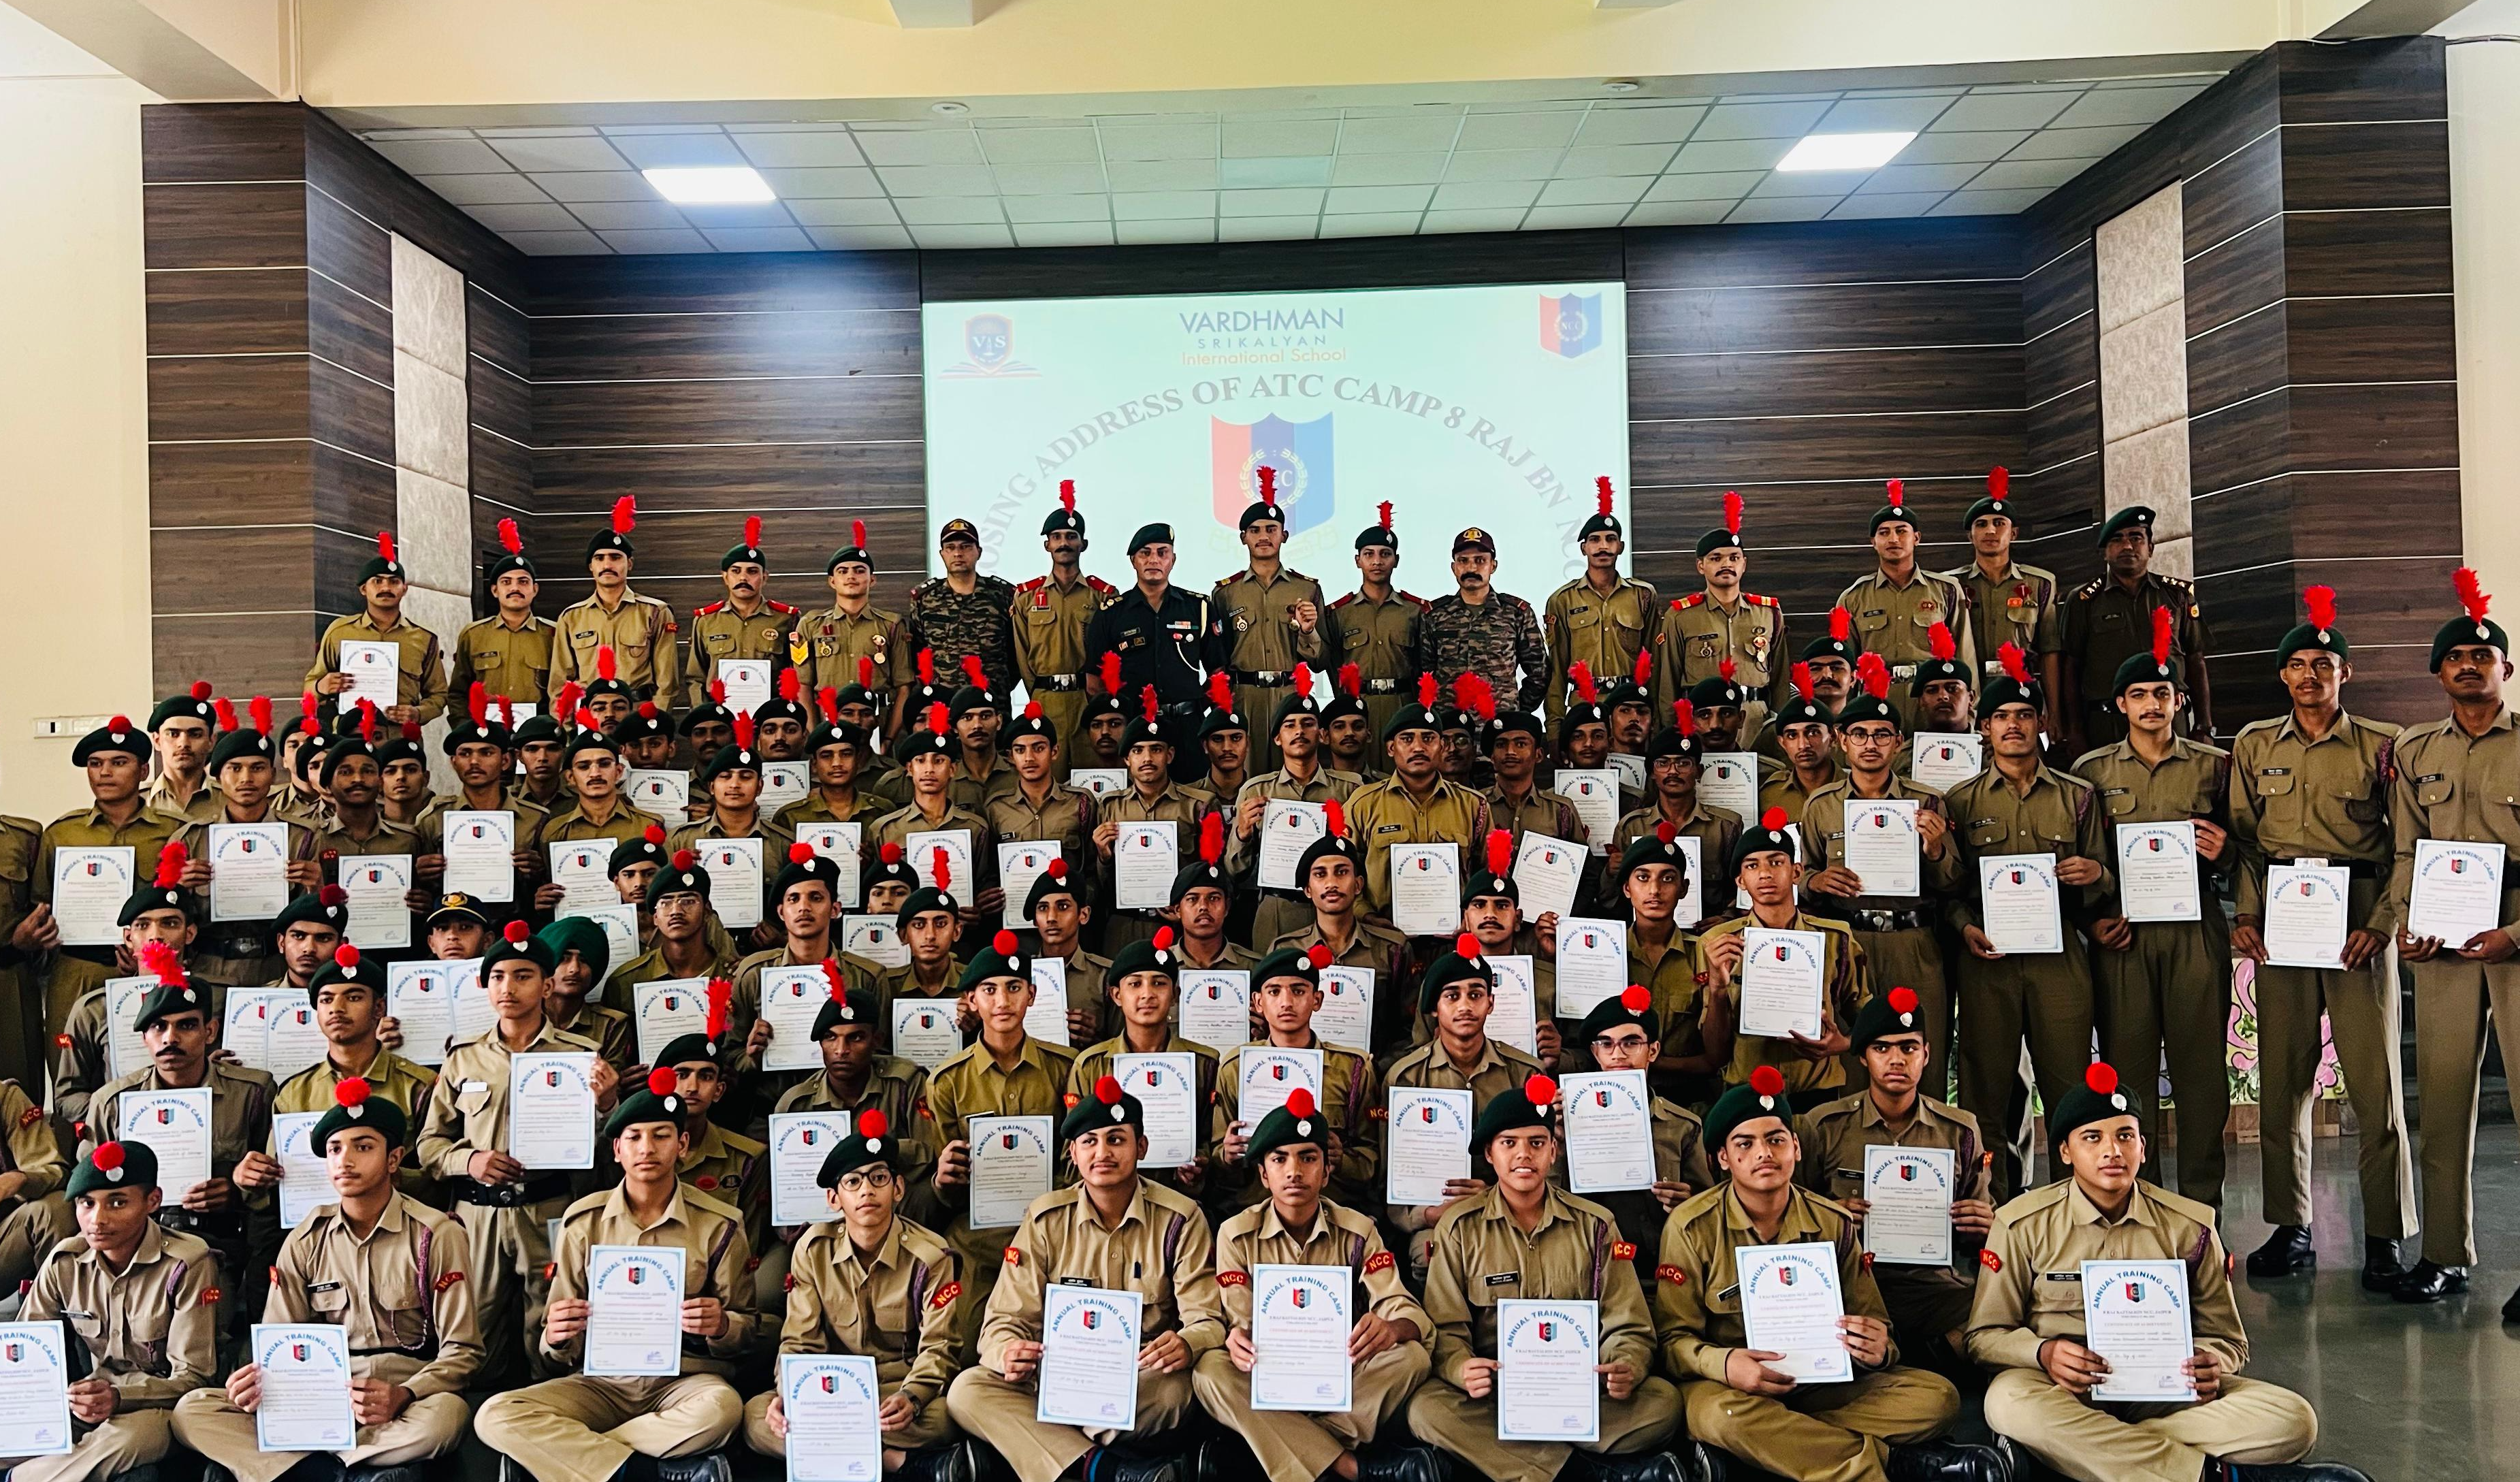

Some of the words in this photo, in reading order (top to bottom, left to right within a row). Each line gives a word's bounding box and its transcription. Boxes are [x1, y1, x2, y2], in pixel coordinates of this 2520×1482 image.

[1179, 308, 1344, 334] VARDHMAN
[1182, 349, 1285, 366] International
[1291, 347, 1346, 362] School
[1198, 335, 1326, 349] SRIKALYAN
[978, 472, 1037, 570] OSING
[1035, 388, 1184, 479] ADDRESS
[1192, 377, 1242, 405] OF
[1250, 374, 1324, 398] ATC
[1334, 377, 1444, 419] CAMP
[1444, 406, 1467, 429] 8
[1465, 415, 1537, 468] RAJ
[1524, 463, 1572, 509] BN
[1492, 964, 1515, 974] AINING
[1770, 937, 1805, 950] TRAINING
[1805, 950, 1816, 969] CAMP
[519, 1067, 539, 1093] ANNUAL
[540, 1061, 577, 1072] TRAINING
[577, 1072, 589, 1092] CAMP
[1141, 1061, 1176, 1072] TRAINING
[1176, 1072, 1189, 1092] CAMP
[1246, 1060, 1265, 1084] ANNUAL
[1267, 1055, 1303, 1068] TRAINING
[1303, 1068, 1315, 1089] CAMP
[1570, 1088, 1588, 1114] ANNUAL
[1589, 1080, 1626, 1092] TRAINING
[1627, 1091, 1641, 1111] CAMP
[22, 1108, 40, 1125] NCC
[128, 1106, 150, 1132] ANNUAL
[151, 1099, 190, 1109] TRAINING
[191, 1109, 204, 1128] CAMP
[1395, 1101, 1415, 1127] ANNUAL
[1417, 1097, 1453, 1110] TRAINING
[1453, 1110, 1465, 1131] CAMP
[283, 1127, 302, 1153] ANNUAL
[777, 1126, 796, 1152] ANNUAL
[796, 1121, 831, 1130] TRAINING
[977, 1131, 996, 1157] ANNUAL
[997, 1125, 1033, 1136] TRAINING
[1033, 1135, 1045, 1154] CAMP
[1872, 1160, 1893, 1185] ANNUAL
[1894, 1155, 1933, 1168] TRAINING
[1933, 1168, 1945, 1188] CAMP
[597, 1261, 620, 1290] ANNUAL
[622, 1255, 662, 1270] TRAINING
[662, 1270, 675, 1291] CAMP
[1369, 1255, 1389, 1271] NCC
[1660, 1268, 1682, 1280] NCC
[1749, 1263, 1770, 1294] ANNUAL
[1771, 1255, 1813, 1268] TRAINING
[1815, 1267, 1832, 1290] CAMP
[1982, 1255, 1997, 1268] NCC
[937, 1285, 958, 1304] NCC
[1222, 1273, 1244, 1285] NCC
[2093, 1278, 2115, 1309] ANNUAL
[2116, 1270, 2163, 1285] TRAINING
[2163, 1285, 2180, 1309] CAMP
[1261, 1283, 1285, 1314] ANNUAL
[1285, 1276, 1328, 1291] TRAINING
[1329, 1291, 1343, 1317] CAMP
[1052, 1302, 1076, 1332] ANNUAL
[1078, 1298, 1119, 1315] TRAINING
[1118, 1315, 1131, 1340] CAMP
[1507, 1317, 1530, 1348] ANNUAL
[1531, 1310, 1575, 1325] TRAINING
[1575, 1325, 1590, 1349] CAMP
[42, 1344, 57, 1366] CAMP
[263, 1340, 285, 1368] ANNUAL
[285, 1333, 326, 1346] TRAINING
[327, 1347, 342, 1368] CAMP
[792, 1371, 813, 1400] ANNUAL
[813, 1364, 855, 1379] TRAINING
[856, 1377, 871, 1400] CAMP
